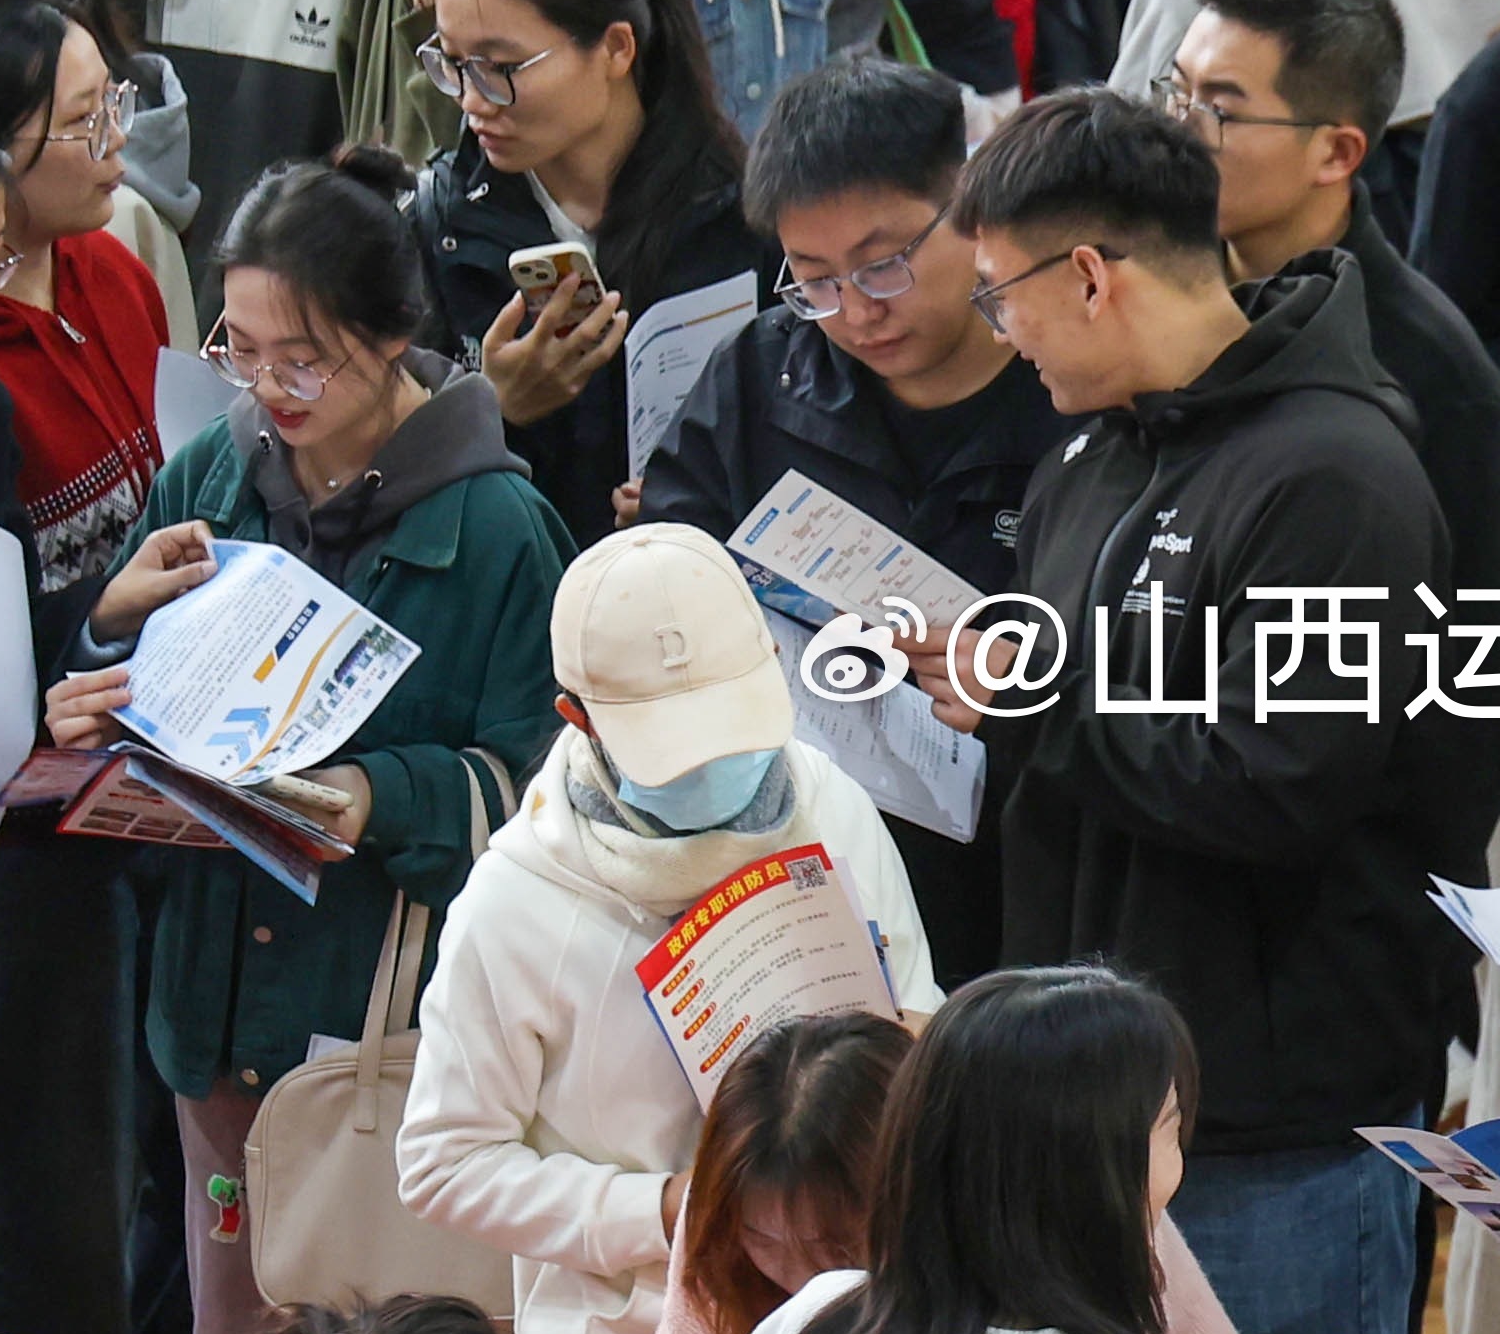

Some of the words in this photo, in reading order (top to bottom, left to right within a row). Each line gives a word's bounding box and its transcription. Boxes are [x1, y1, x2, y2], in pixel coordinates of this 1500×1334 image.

[666, 860, 787, 959] 政府专职消防员
